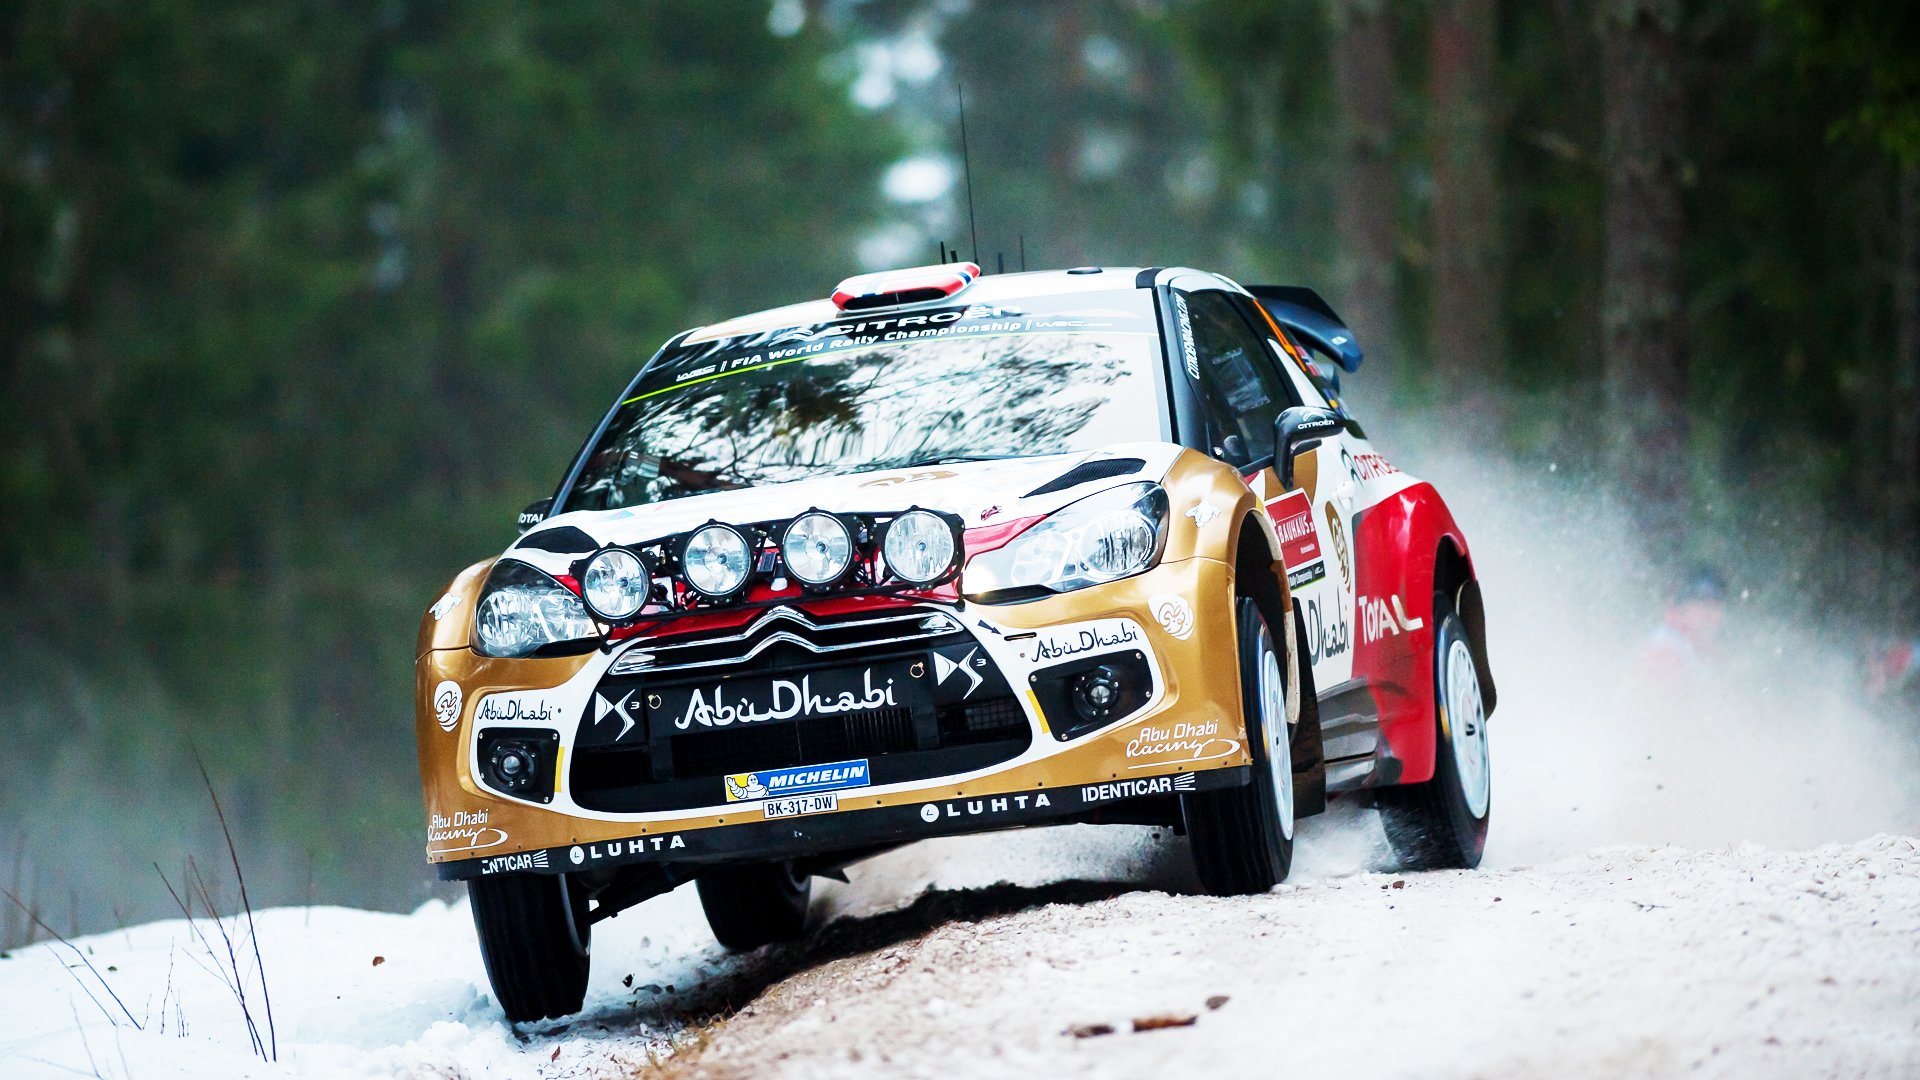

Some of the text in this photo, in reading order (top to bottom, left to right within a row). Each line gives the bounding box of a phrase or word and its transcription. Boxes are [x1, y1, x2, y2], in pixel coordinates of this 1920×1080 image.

[731, 354, 762, 369] FIA
[769, 342, 825, 361] World
[829, 334, 878, 349] Rally
[884, 321, 1022, 341] Championship
[1278, 513, 1310, 544] BAUHAUS
[1139, 719, 1219, 744] Abu Dhabi
[1126, 737, 1216, 759] Racing
[769, 766, 865, 788] MICHELIN
[1082, 777, 1172, 803] IDENTICAR
[767, 796, 832, 816] BK-317-DW
[946, 793, 1051, 817] LUHTA
[432, 808, 489, 829] Abu Dhabi
[589, 834, 686, 859] LUHTA
